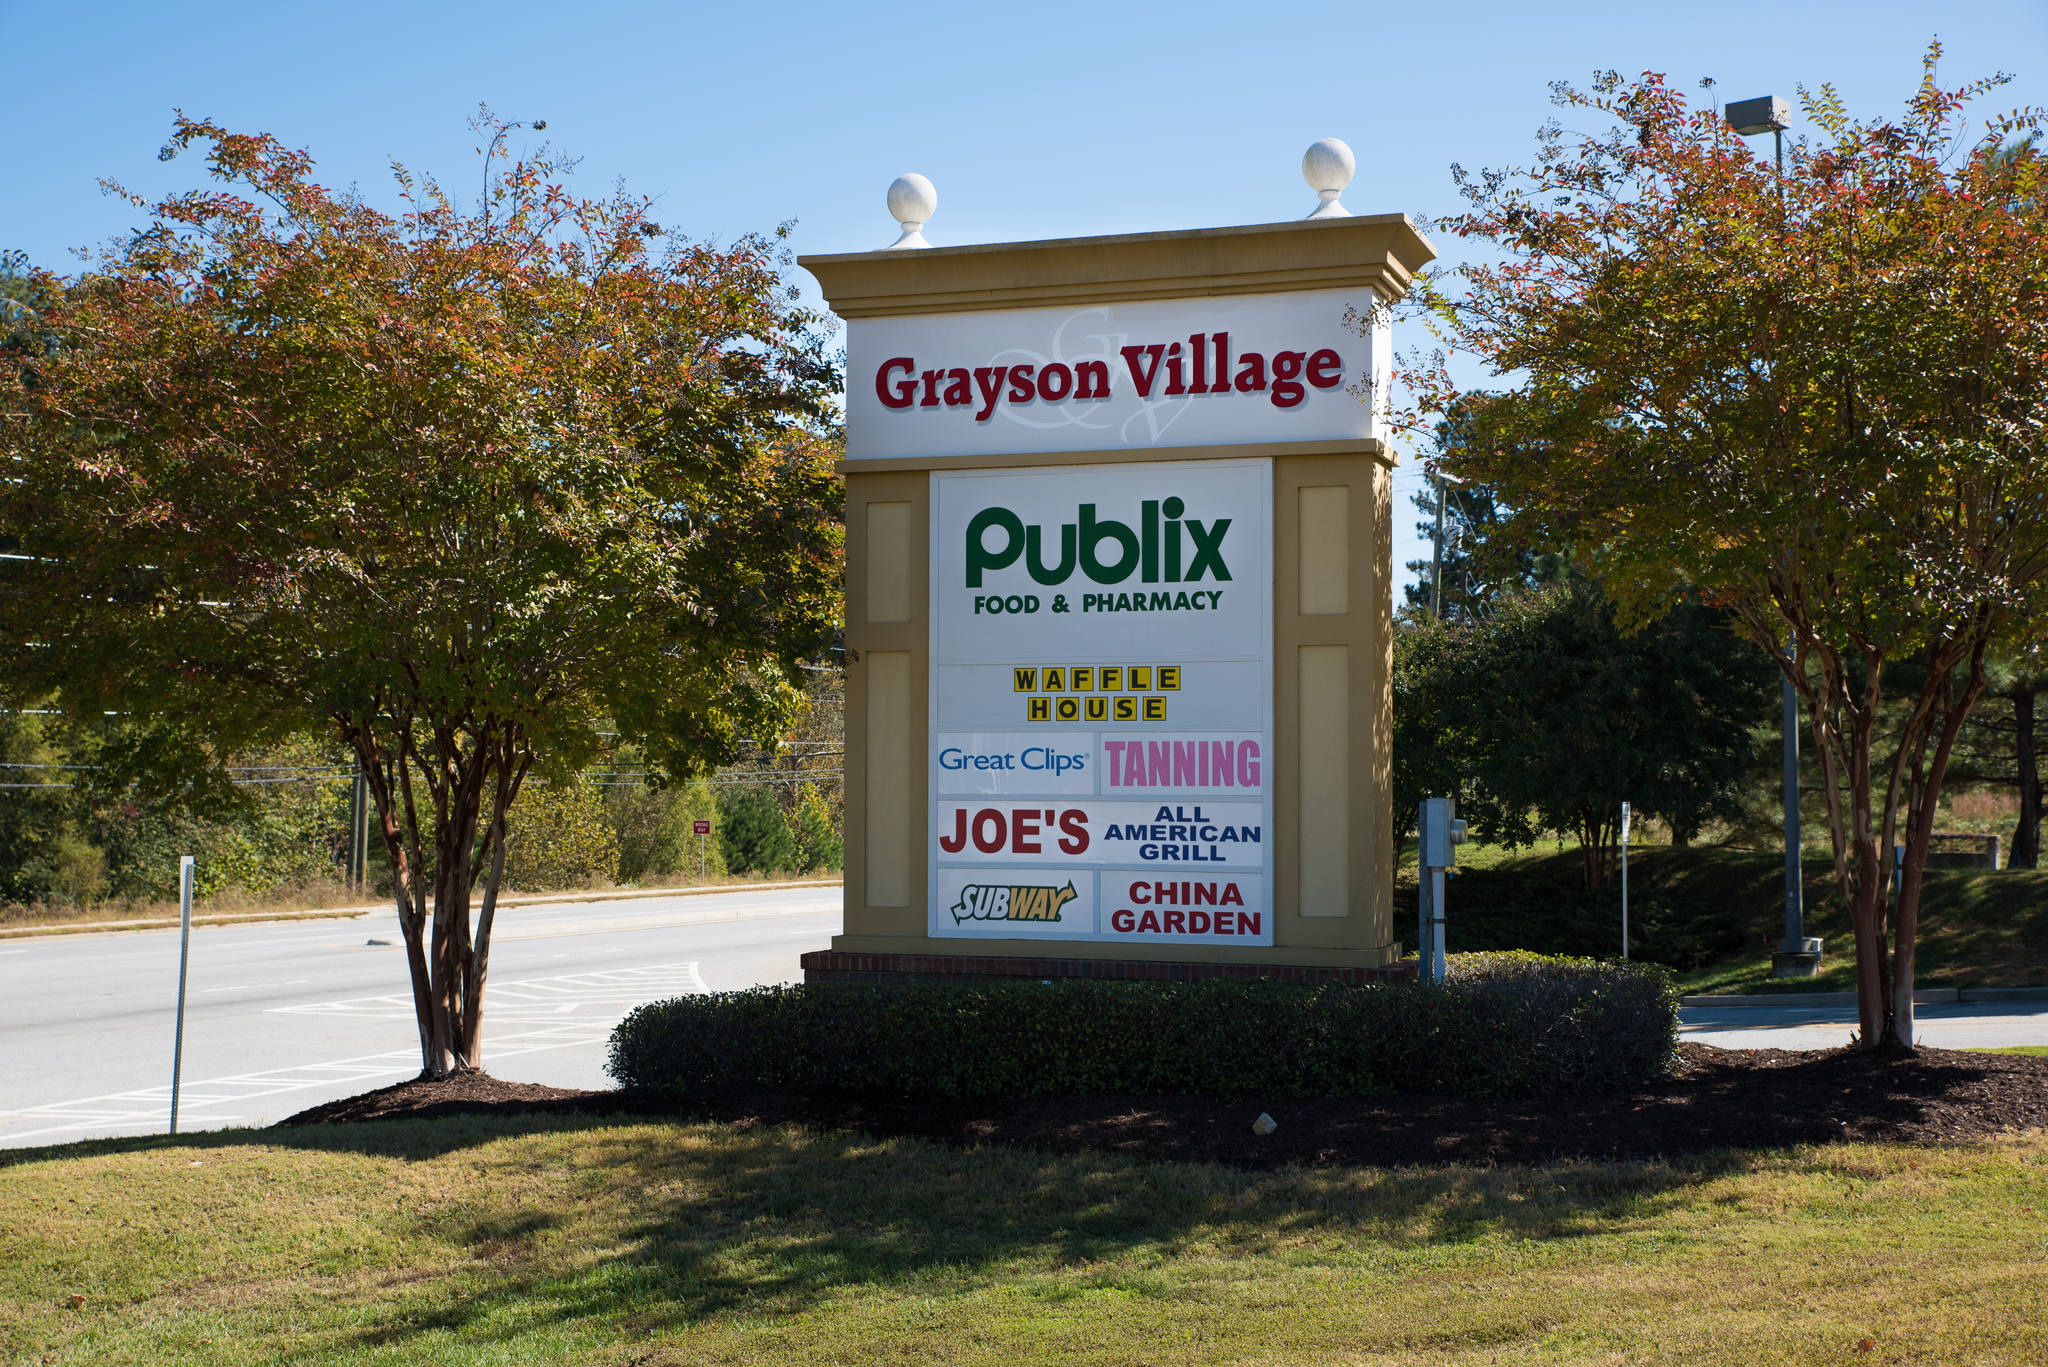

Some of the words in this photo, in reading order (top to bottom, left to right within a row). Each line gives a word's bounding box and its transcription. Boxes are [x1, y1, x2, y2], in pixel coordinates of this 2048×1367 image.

[876, 357, 1110, 421] Grayson
[1120, 332, 1341, 408] Village
[966, 496, 1233, 588] Publix
[974, 595, 1040, 614] FOOD
[1052, 594, 1070, 613] &
[1083, 591, 1223, 613] PHARMACY
[1015, 667, 1179, 691] WAFFLE
[1030, 697, 1165, 720] HOUSE
[938, 748, 1015, 771] Great
[1104, 739, 1261, 788] TANNING
[1154, 806, 1210, 823] ALL
[939, 808, 1090, 855] JOE'S
[1103, 824, 1261, 843] AMERICAN
[1139, 844, 1226, 861] GRILL
[951, 879, 1078, 925] SUBWAY
[1129, 881, 1244, 906] CHINA
[1111, 910, 1261, 935] GARDEN
